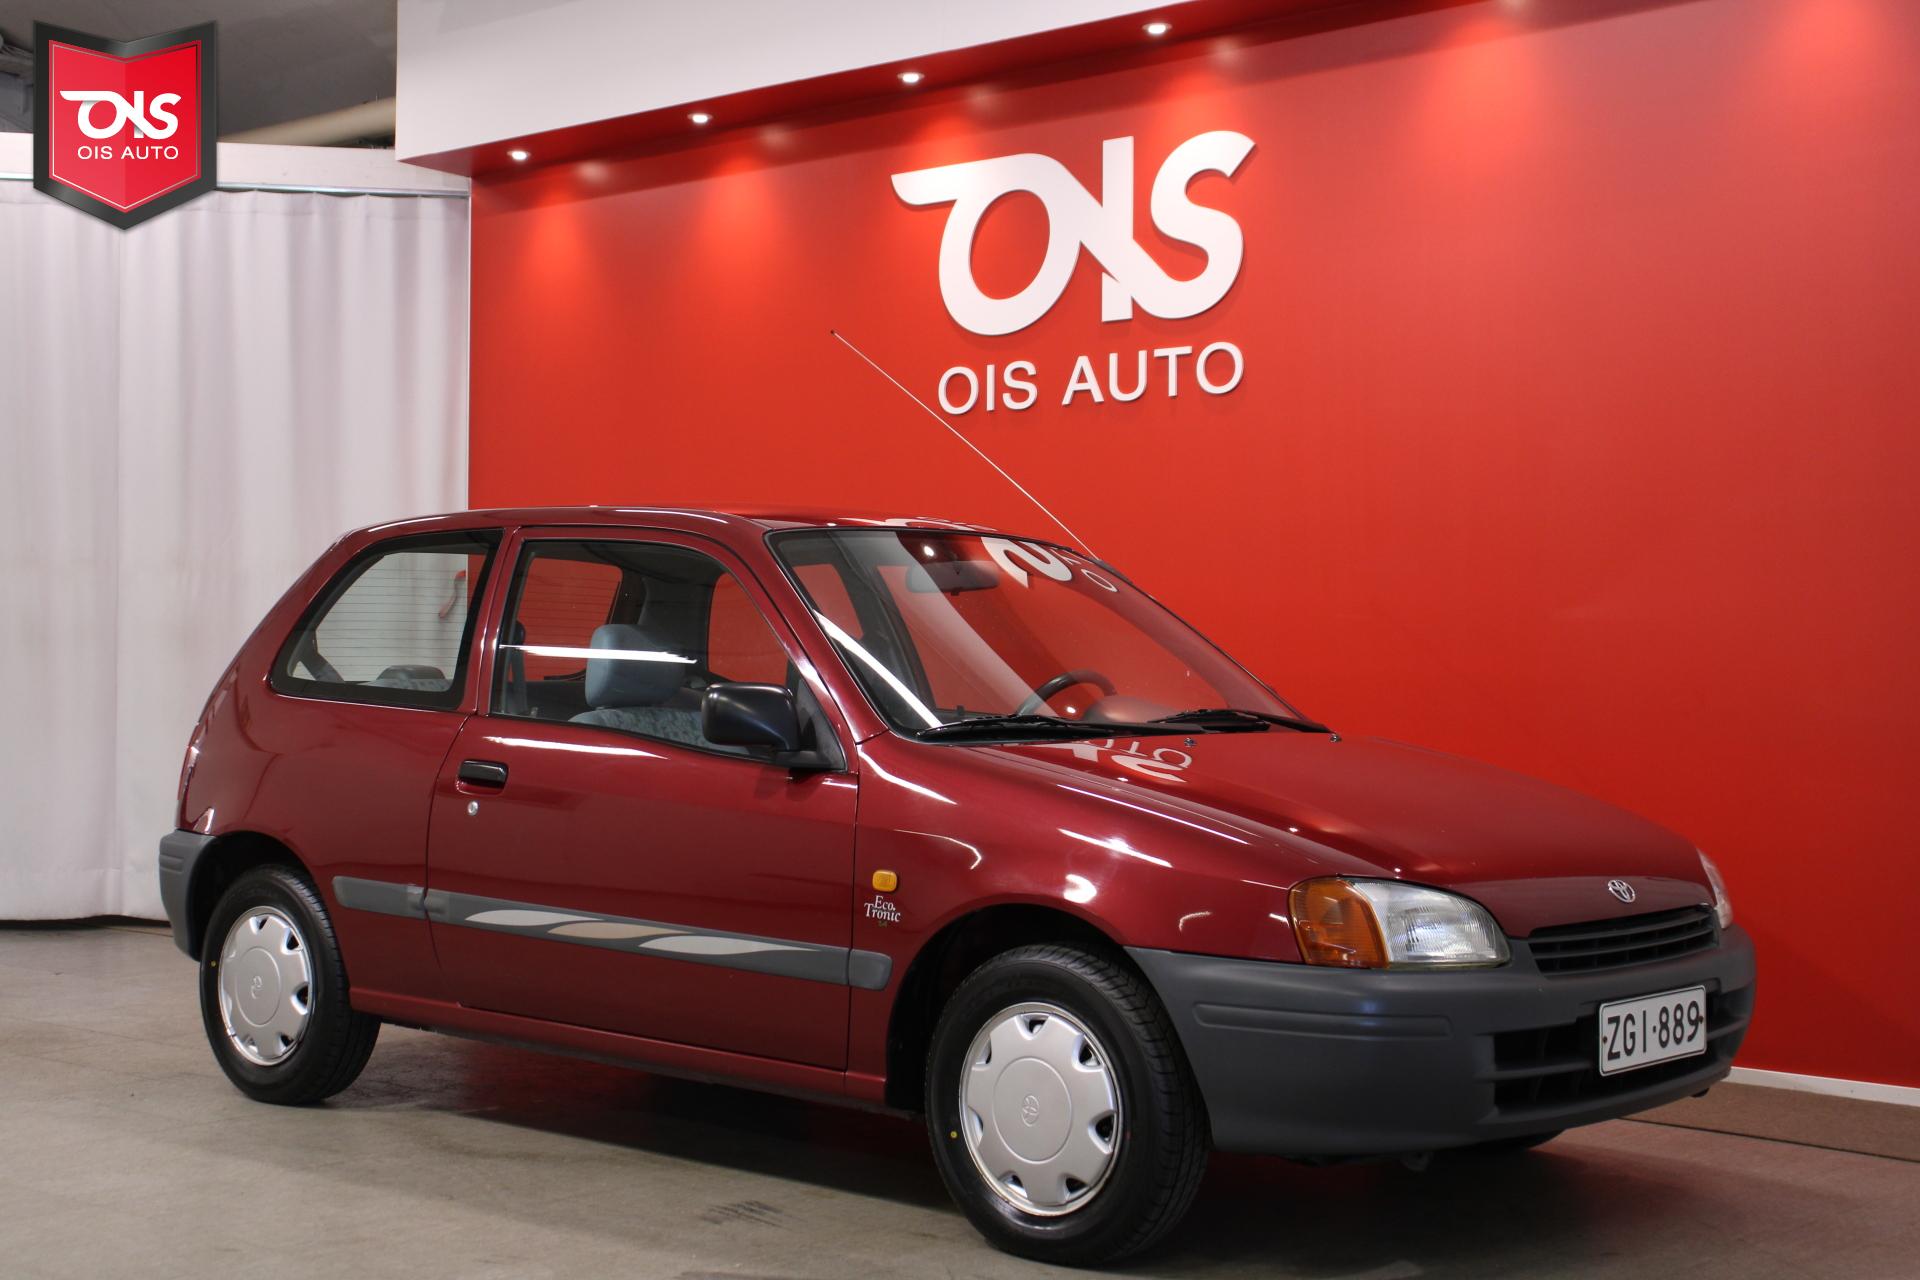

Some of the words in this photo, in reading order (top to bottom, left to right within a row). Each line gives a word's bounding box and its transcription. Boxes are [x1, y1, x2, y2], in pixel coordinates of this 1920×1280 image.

[937, 360, 1038, 415] OIS
[1061, 341, 1245, 406] AUTO
[864, 902, 901, 922] Tronic
